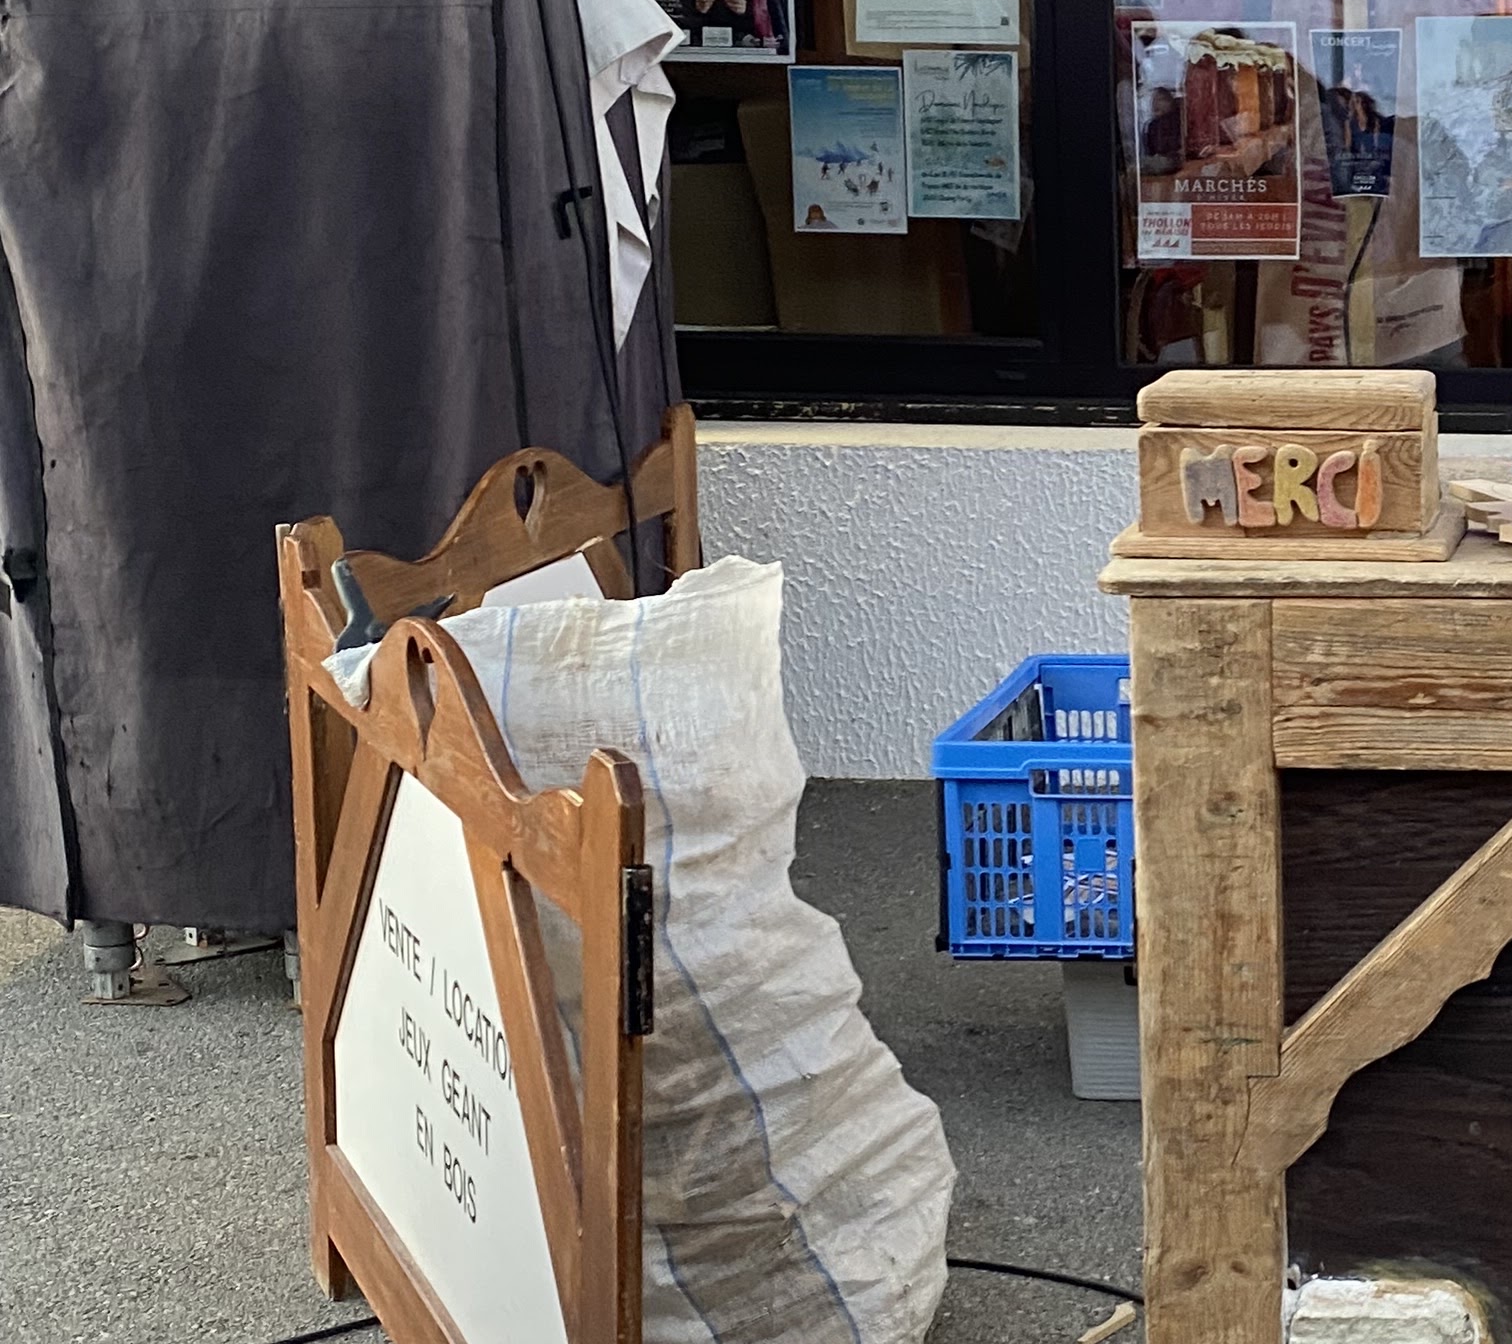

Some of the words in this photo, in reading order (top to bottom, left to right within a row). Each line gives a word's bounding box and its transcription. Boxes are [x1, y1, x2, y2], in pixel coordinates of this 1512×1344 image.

[1320, 36, 1372, 48] CONCERT
[1174, 176, 1268, 193] MARCHÉS
[1180, 439, 1383, 528] MERCI
[378, 897, 423, 983] VENTE
[398, 1005, 433, 1084] JEUX
[441, 1058, 493, 1156] GEANT
[415, 1103, 435, 1167] EN
[443, 1142, 478, 1225] BOIS
